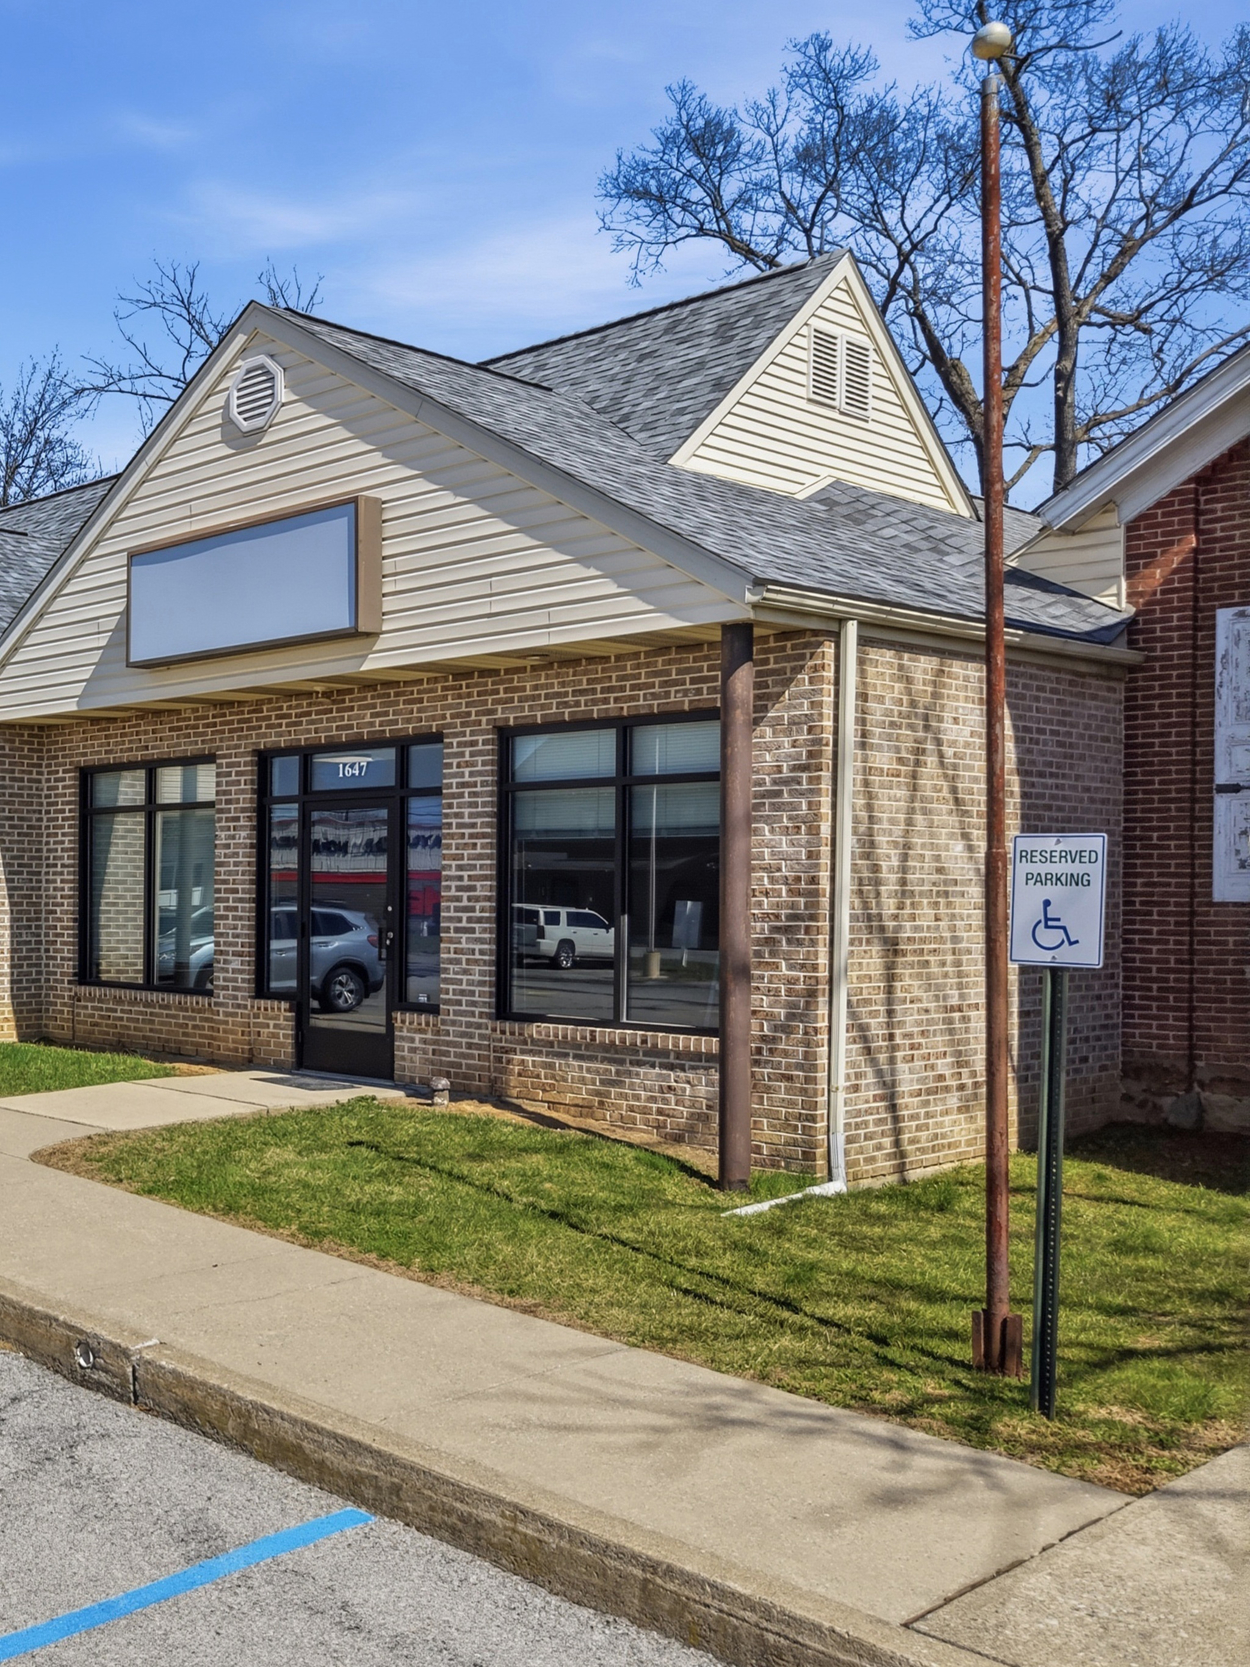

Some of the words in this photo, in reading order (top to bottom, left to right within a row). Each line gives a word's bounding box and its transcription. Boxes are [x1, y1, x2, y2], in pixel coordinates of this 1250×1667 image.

[338, 761, 368, 778] 1647
[1019, 849, 1099, 864] RESERVED
[1025, 872, 1091, 887] PARKING
